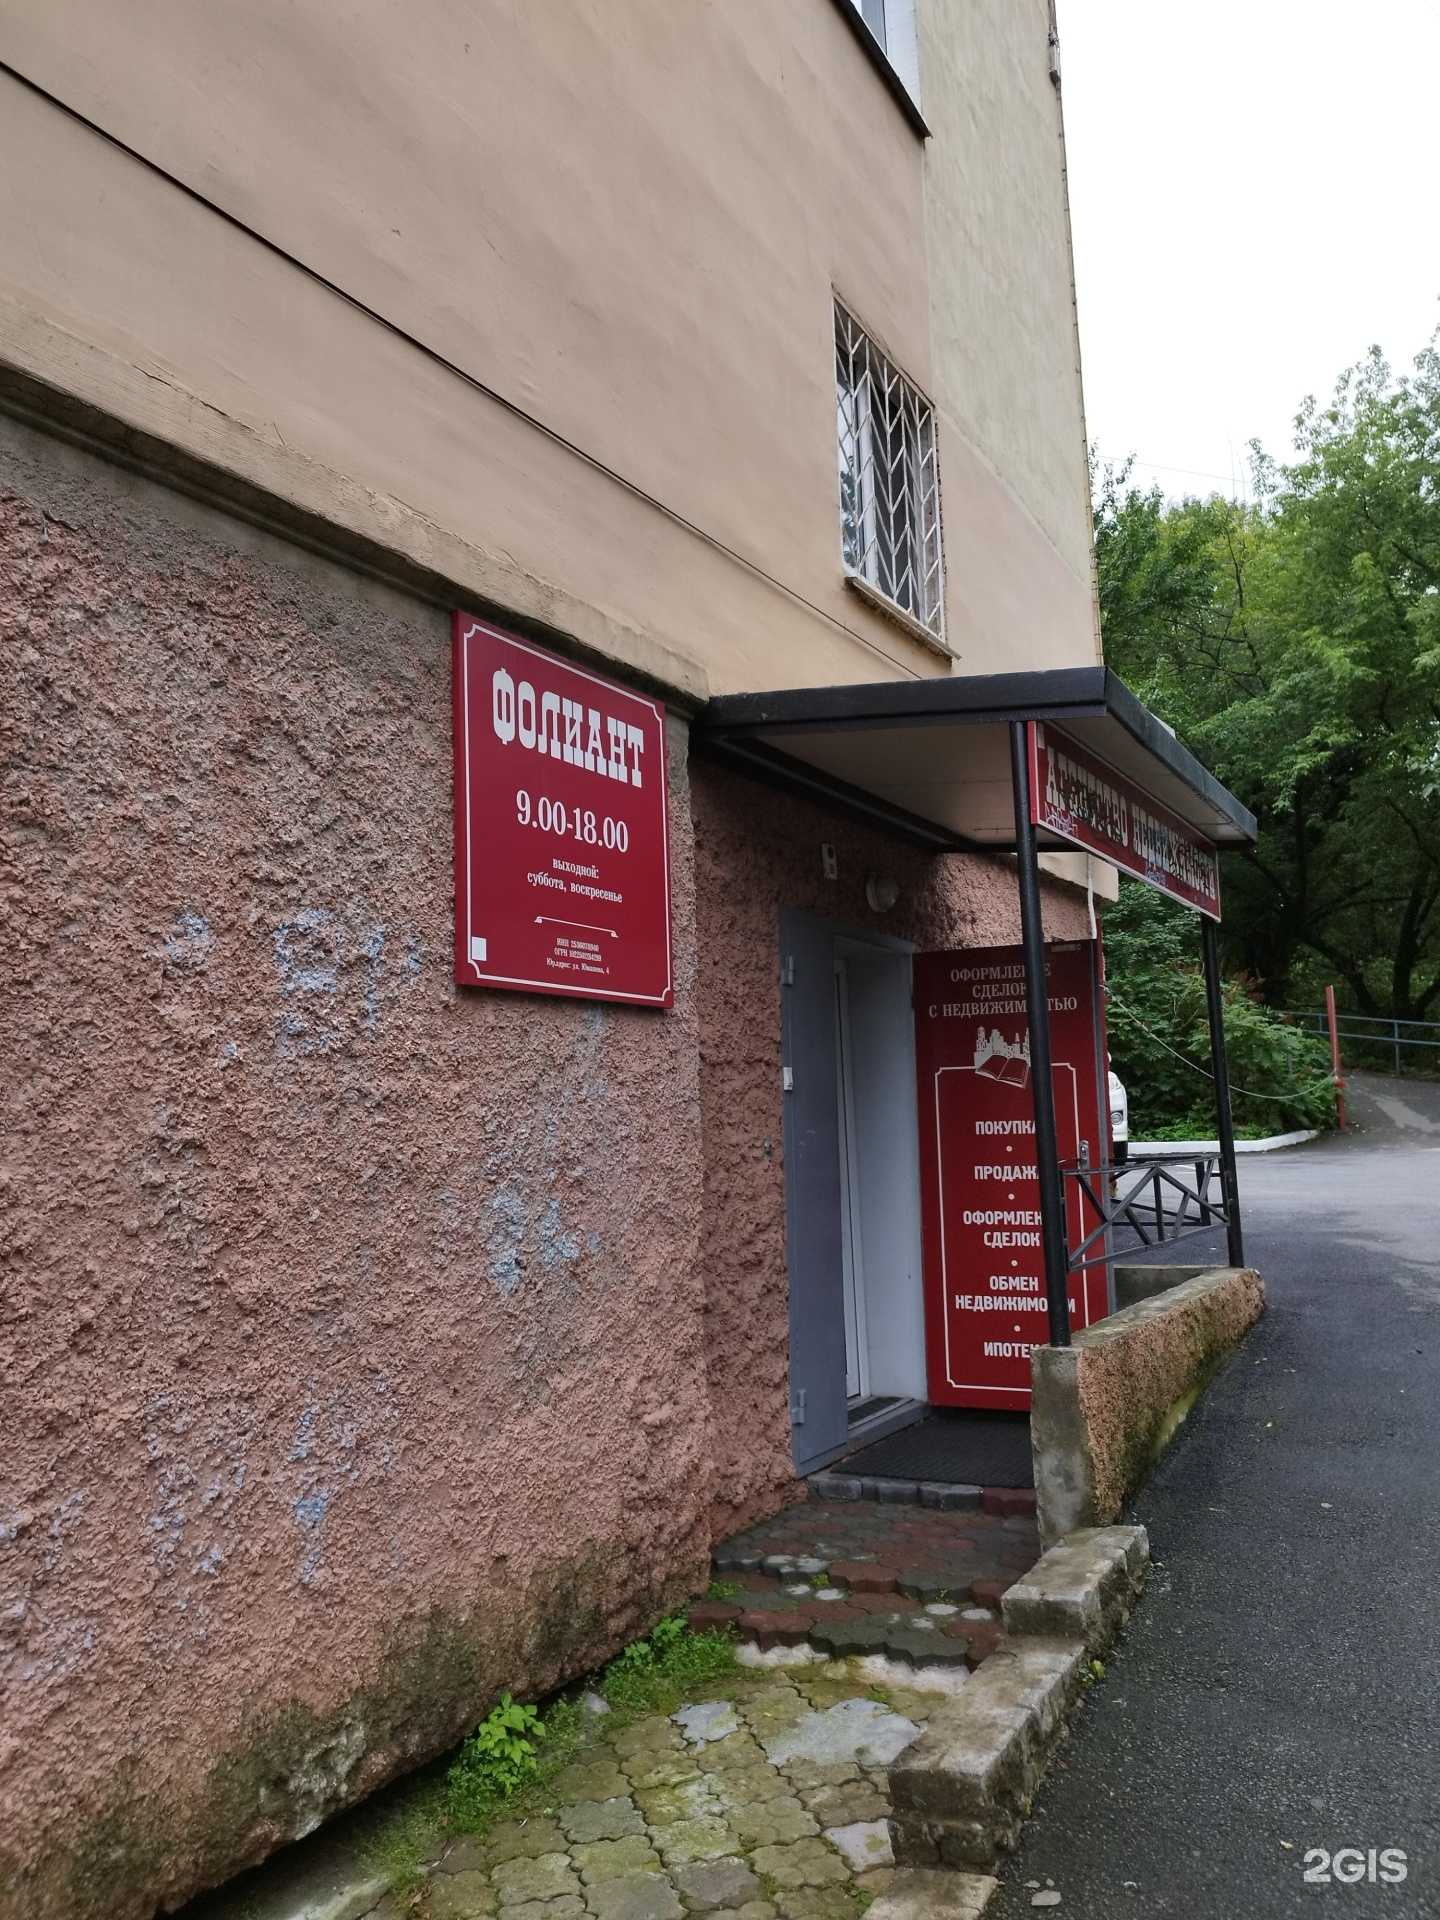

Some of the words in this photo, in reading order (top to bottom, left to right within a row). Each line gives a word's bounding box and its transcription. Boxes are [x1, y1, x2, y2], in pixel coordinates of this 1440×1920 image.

[492, 667, 645, 788] ФОЛИАНТ
[516, 789, 629, 853] 9.00-18.00
[552, 858, 599, 879] выходной:
[527, 871, 567, 892] суббота,
[570, 881, 623, 903] воскресенье
[950, 963, 1051, 982] ОФОРМЛЕЕ
[943, 997, 1078, 1019] НЕДВИЖИМТЬЮ
[974, 1165, 1040, 1182] ПРОДАЖ
[963, 1210, 1043, 1225] ОФОРМЛЕН
[983, 1231, 1040, 1248] СДЕЛОК
[989, 1275, 1040, 1291] ОБМЕН
[955, 1295, 1076, 1313] НЕДВИЖИМОИ
[983, 1341, 1041, 1358] ИПОТЕ
